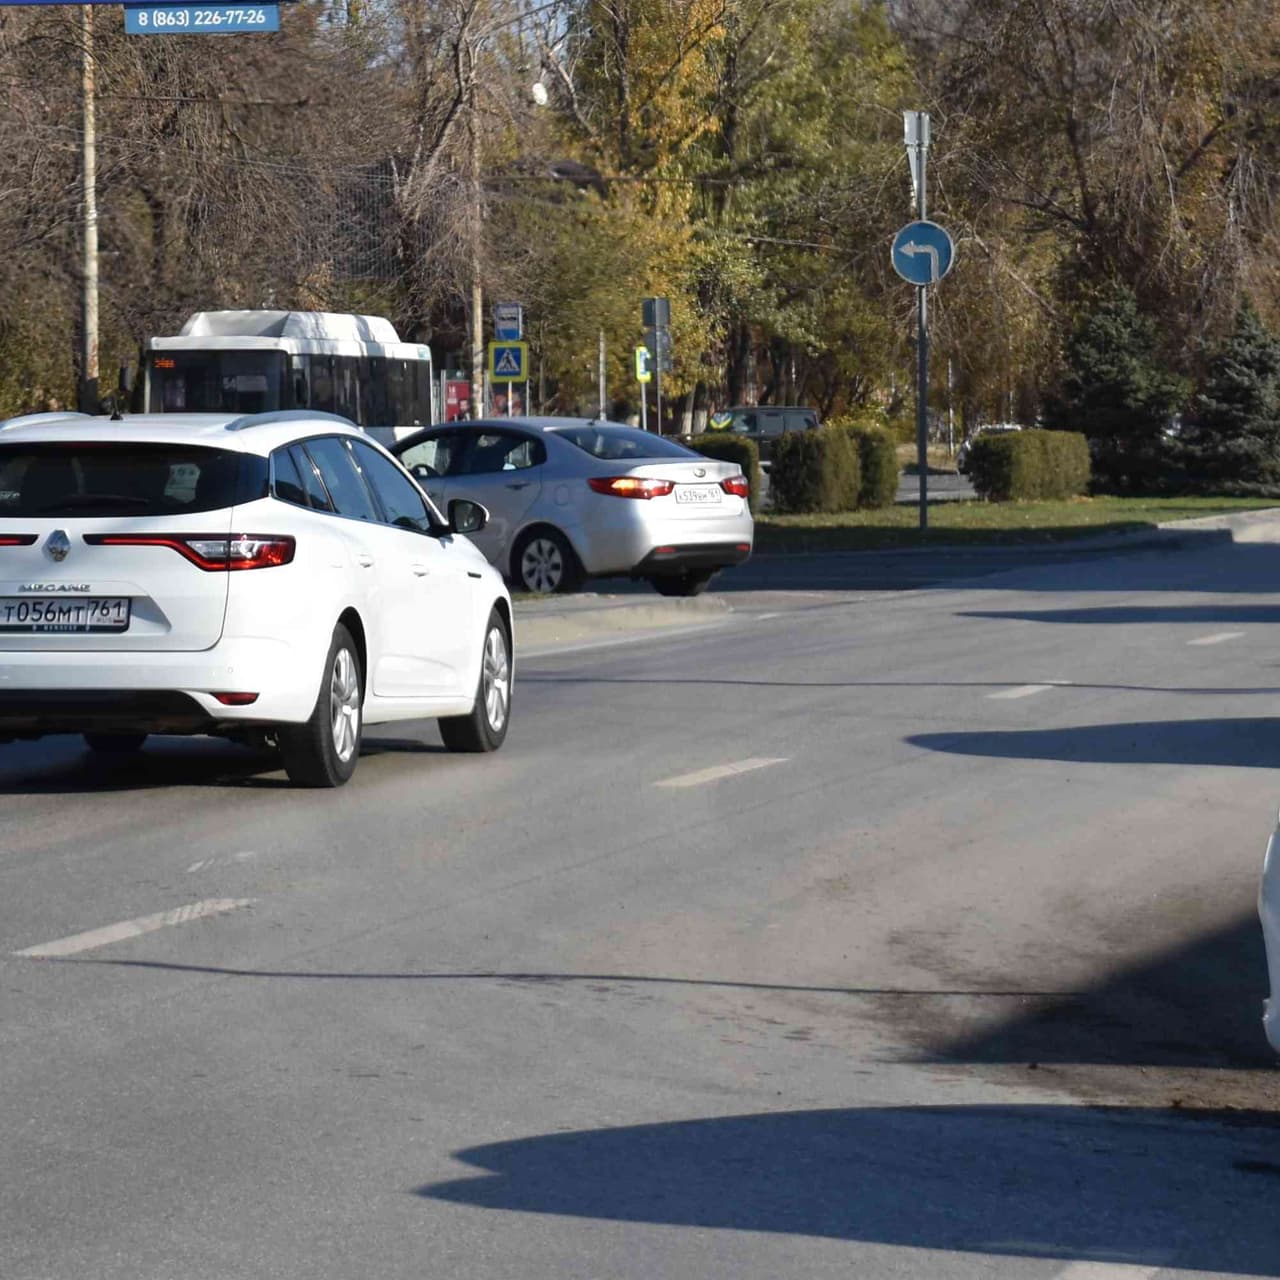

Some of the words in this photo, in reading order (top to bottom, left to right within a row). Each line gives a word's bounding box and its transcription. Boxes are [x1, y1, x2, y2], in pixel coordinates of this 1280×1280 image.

[138, 11, 148, 26] 8
[153, 10, 189, 27] (863)
[194, 9, 266, 25] 226-77-26
[4, 601, 84, 623] Т056МТ
[91, 600, 122, 617] 761
